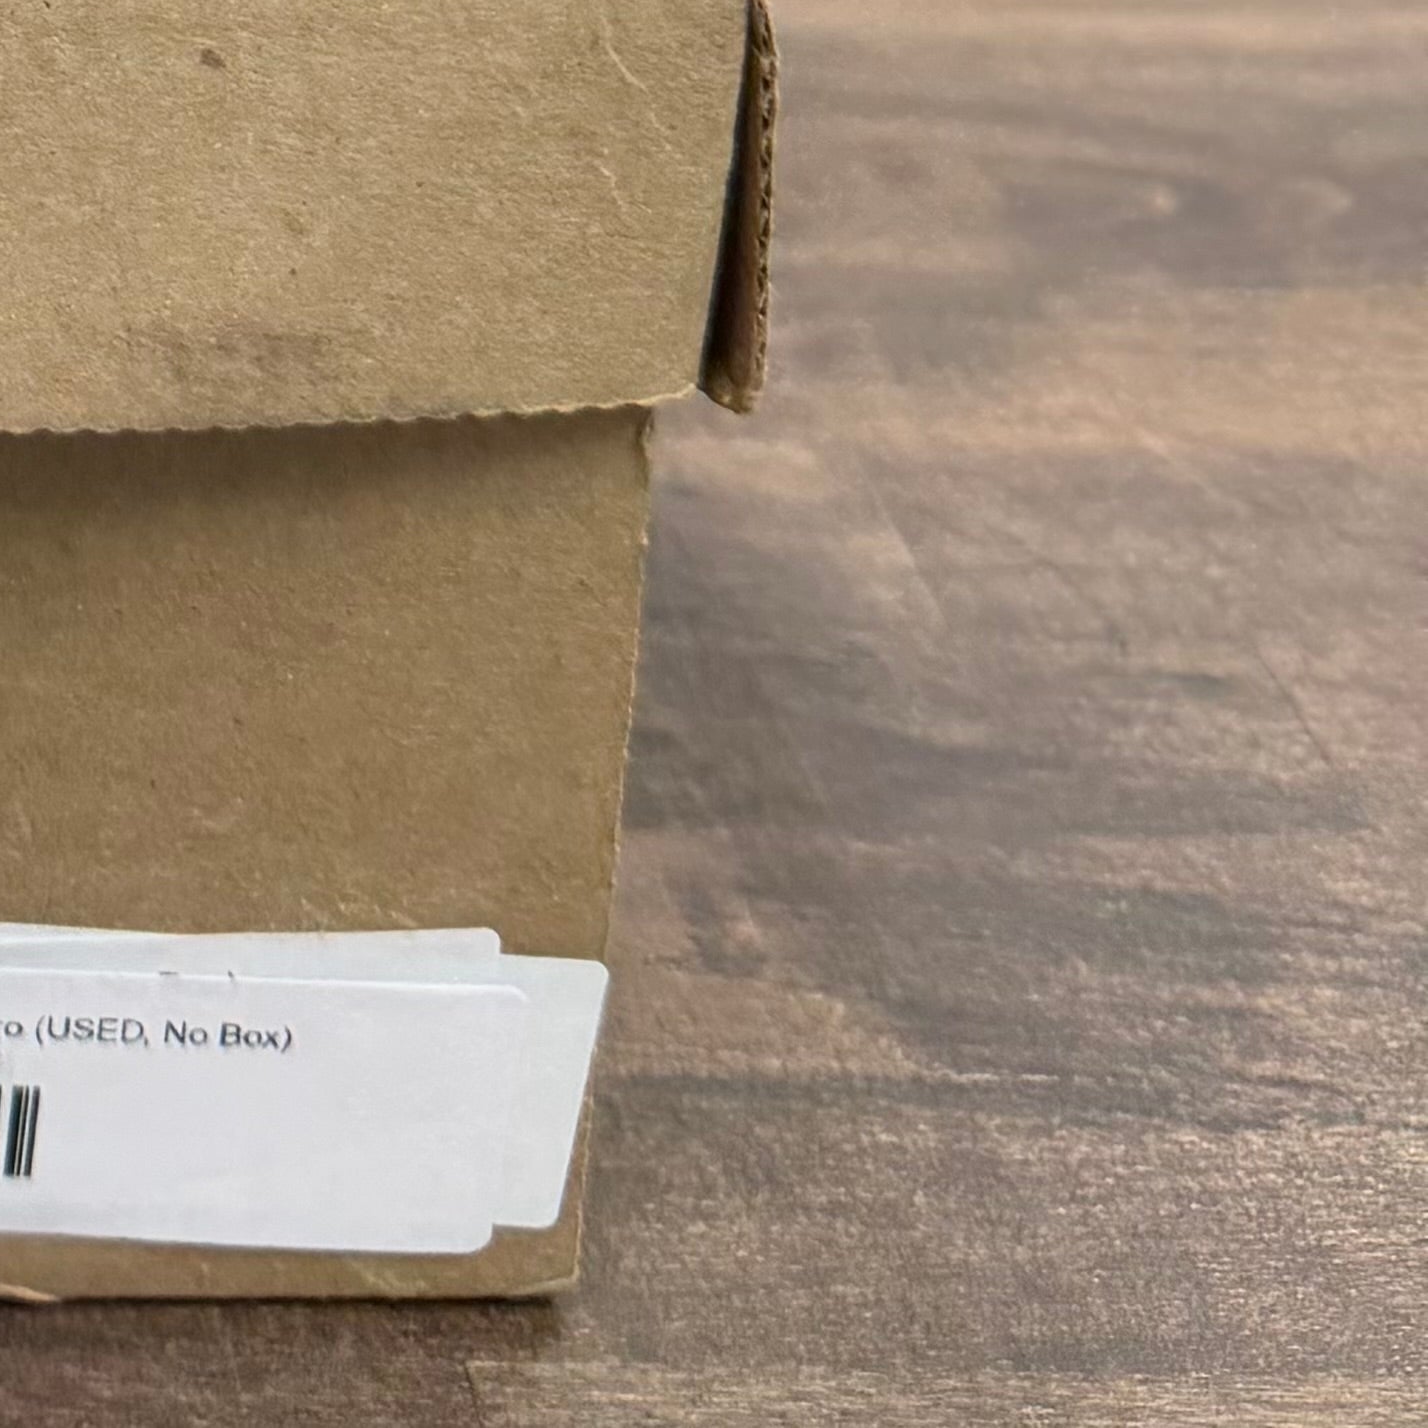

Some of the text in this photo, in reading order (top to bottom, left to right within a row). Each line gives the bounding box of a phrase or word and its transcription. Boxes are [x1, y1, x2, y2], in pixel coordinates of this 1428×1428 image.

[34, 1014, 149, 1046] (USED,
[163, 1020, 208, 1045] No
[219, 1022, 293, 1053] Box)
